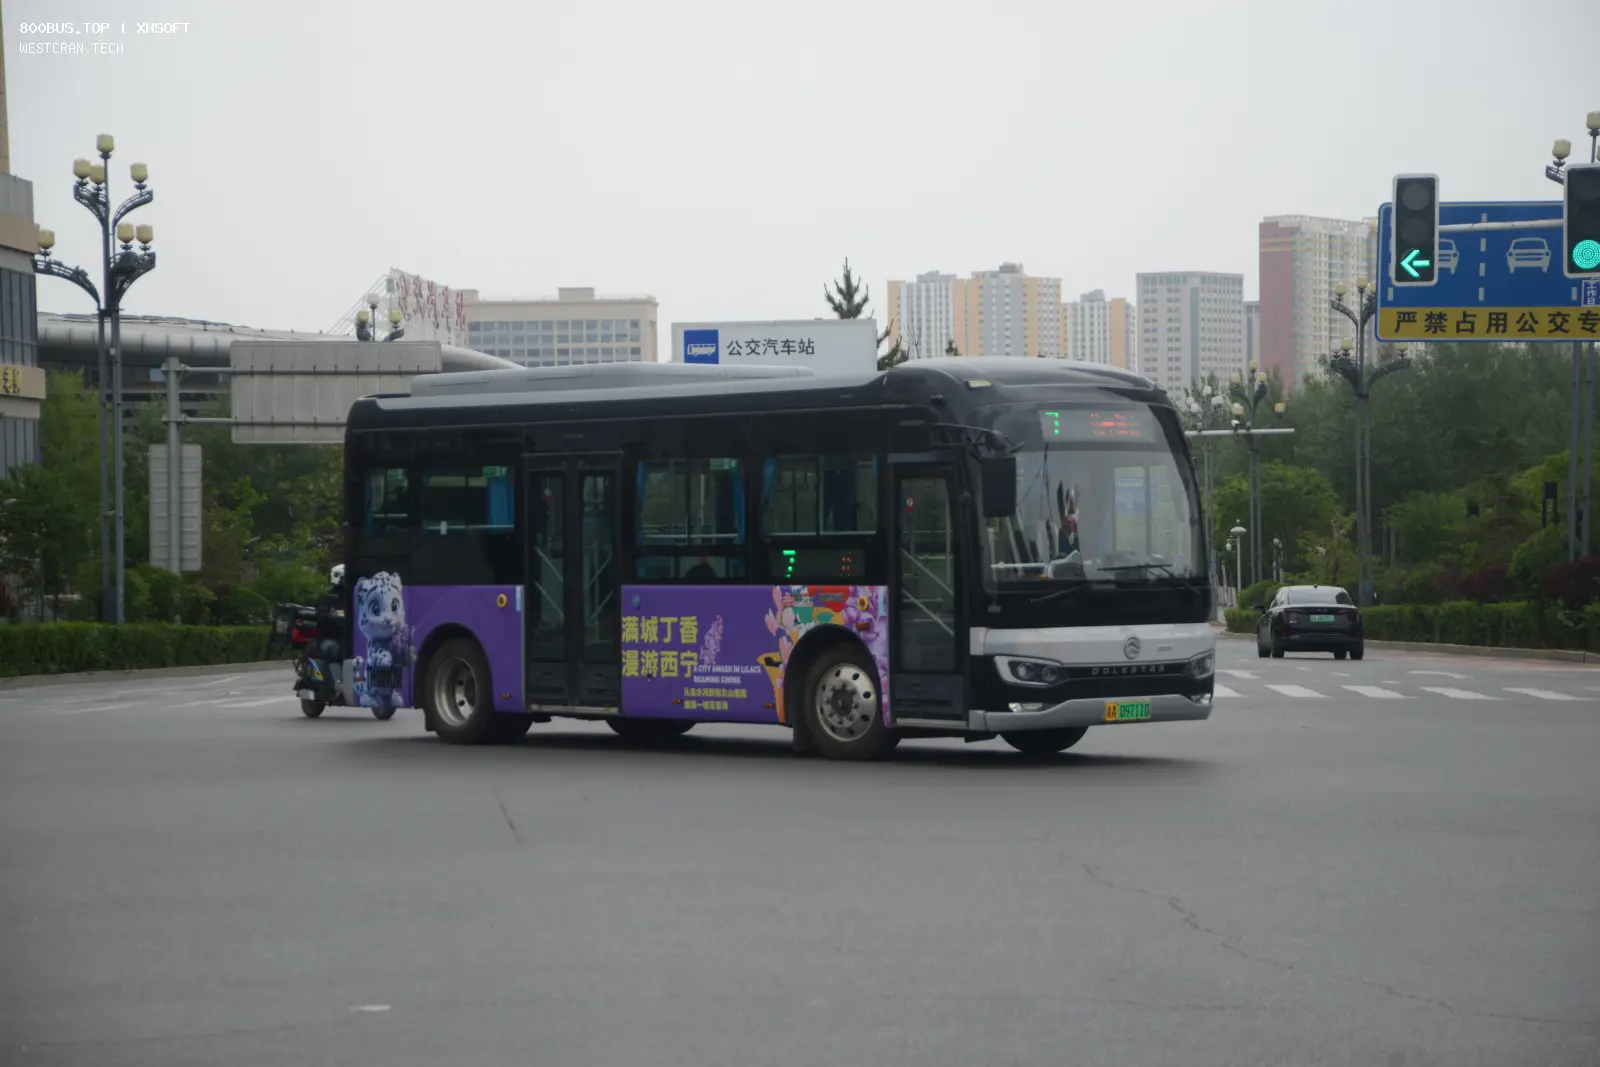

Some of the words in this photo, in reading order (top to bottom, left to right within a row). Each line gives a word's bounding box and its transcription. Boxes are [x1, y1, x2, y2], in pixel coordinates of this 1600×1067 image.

[1394, 310, 1600, 335] 严禁占用公交专
[726, 338, 815, 356] 公交汽车站
[1044, 411, 1060, 436] 7
[781, 549, 796, 577] 7
[621, 615, 699, 644] 满城丁香
[621, 649, 699, 678] 漫游西宁
